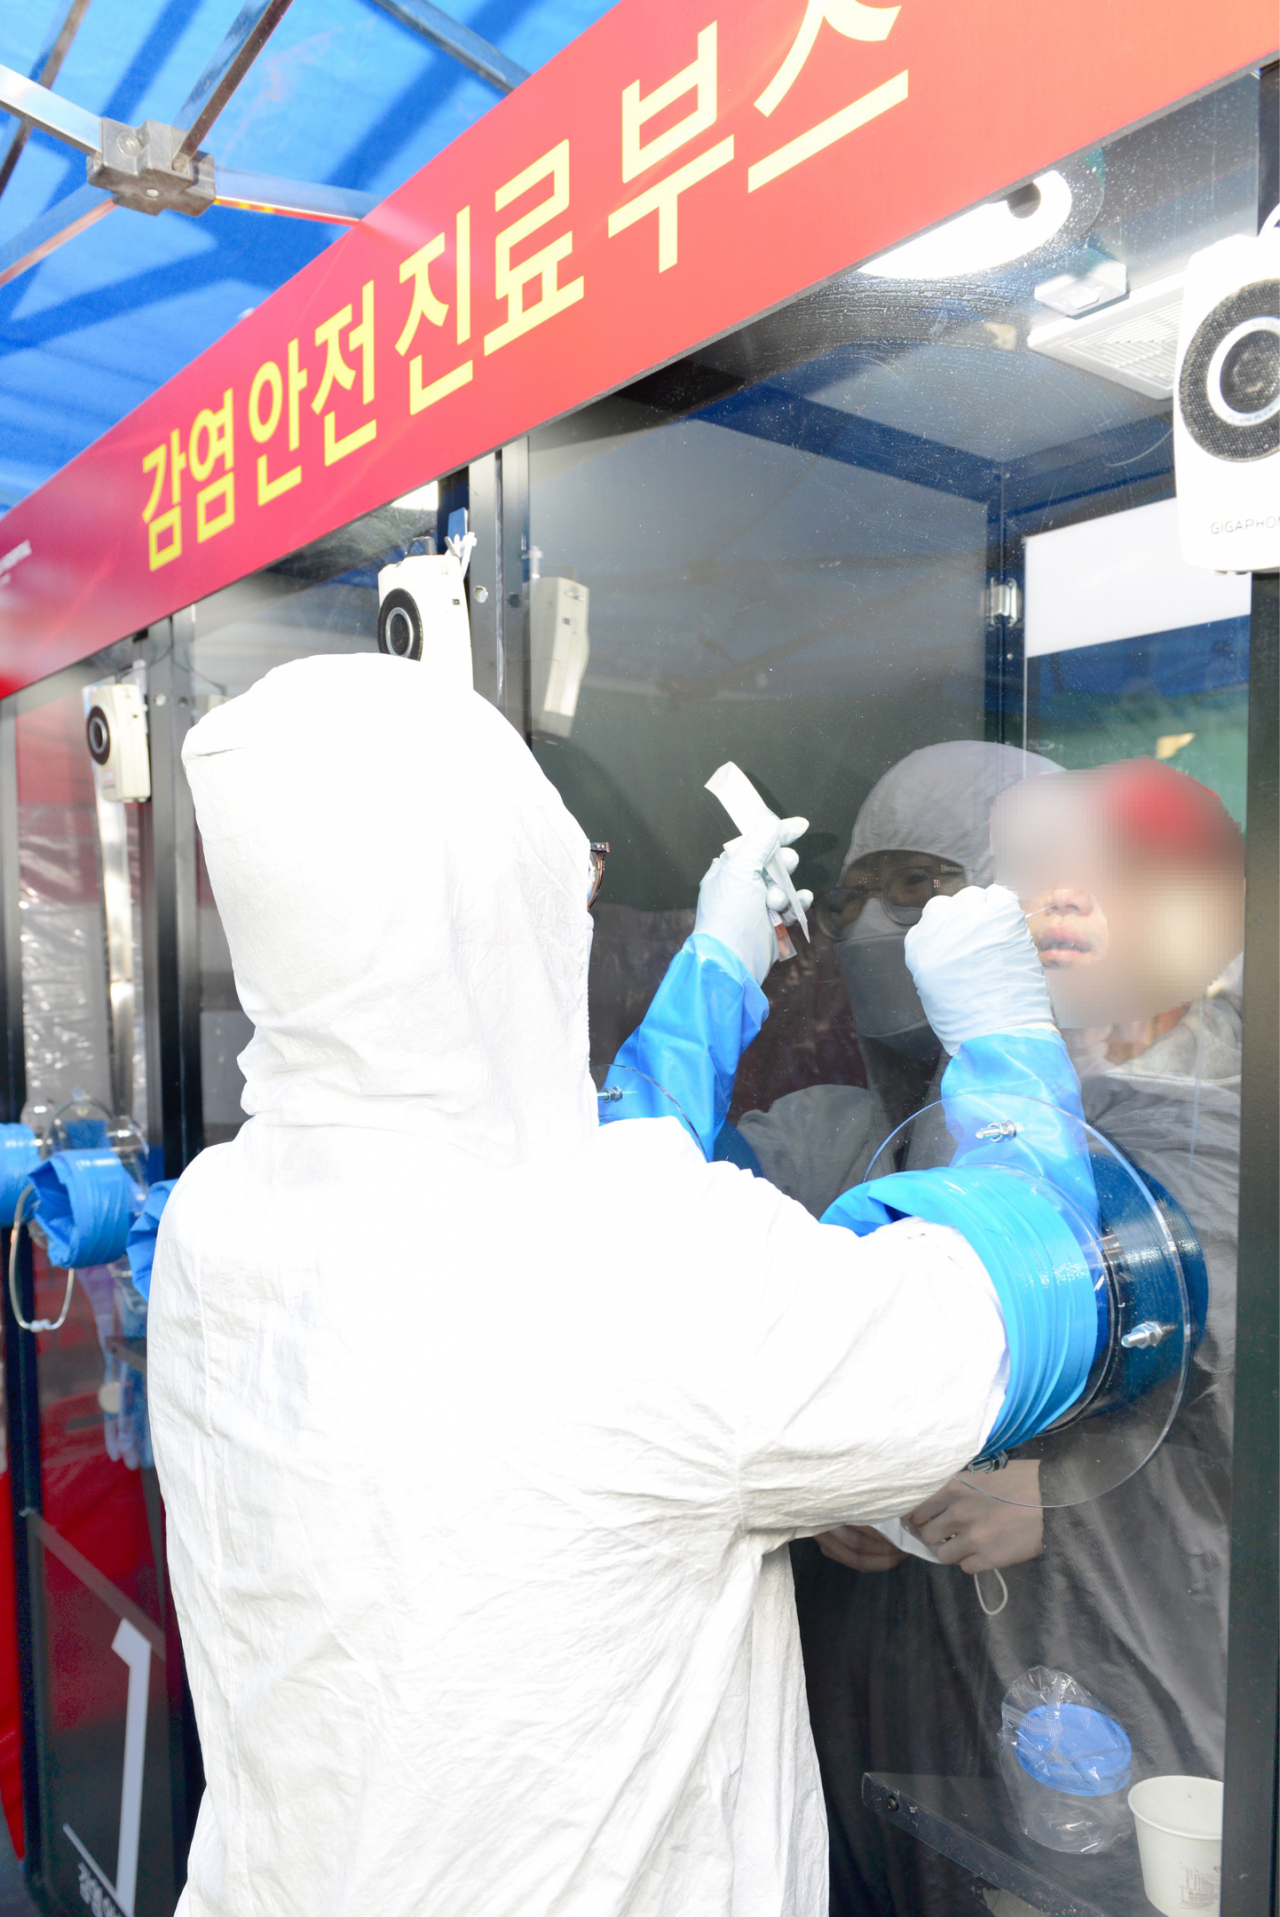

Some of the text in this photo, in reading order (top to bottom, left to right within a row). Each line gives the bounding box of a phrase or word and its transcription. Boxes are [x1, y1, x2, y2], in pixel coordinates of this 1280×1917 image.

[141, 0, 910, 571] 감염 안전 진료 부스
[1210, 515, 1280, 535] GIGAPHO
